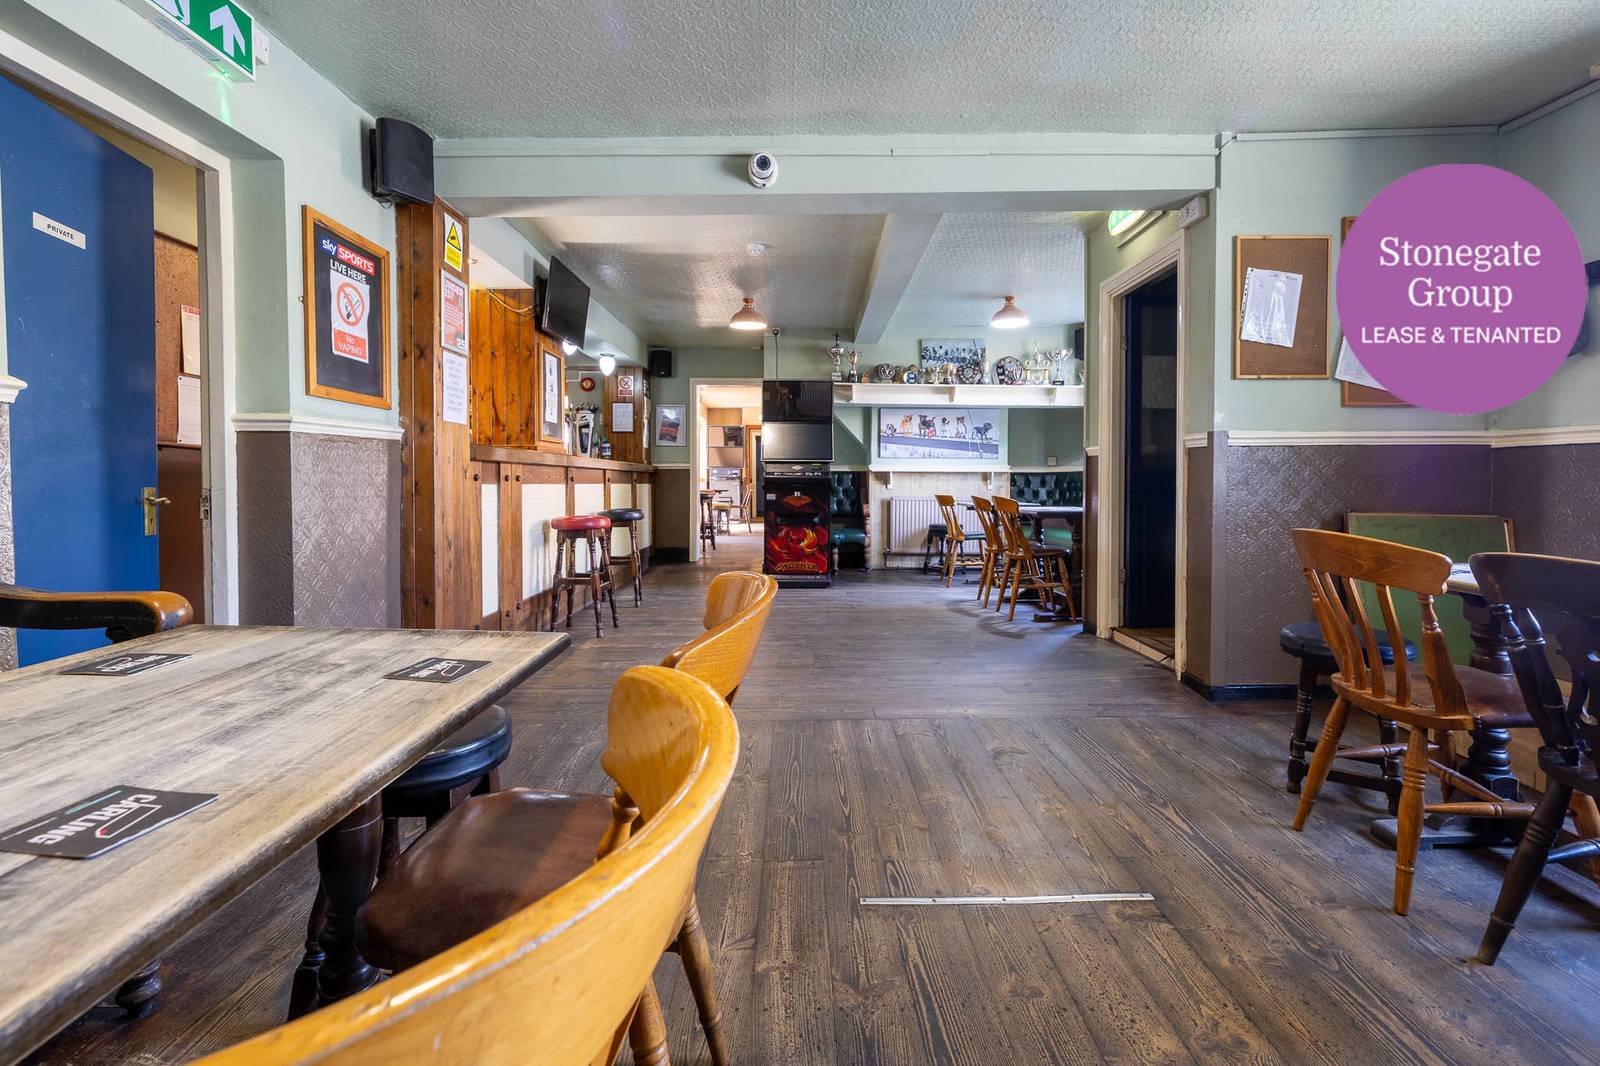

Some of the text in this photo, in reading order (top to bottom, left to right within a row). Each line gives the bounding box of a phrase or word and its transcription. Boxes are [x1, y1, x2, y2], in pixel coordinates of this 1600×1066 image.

[47, 223, 75, 240] PRIVATE
[322, 239, 373, 273] sky SPORTS
[330, 259, 366, 285] LIVE HERE
[338, 341, 363, 357] VAPING
[27, 794, 158, 845] CARLING
